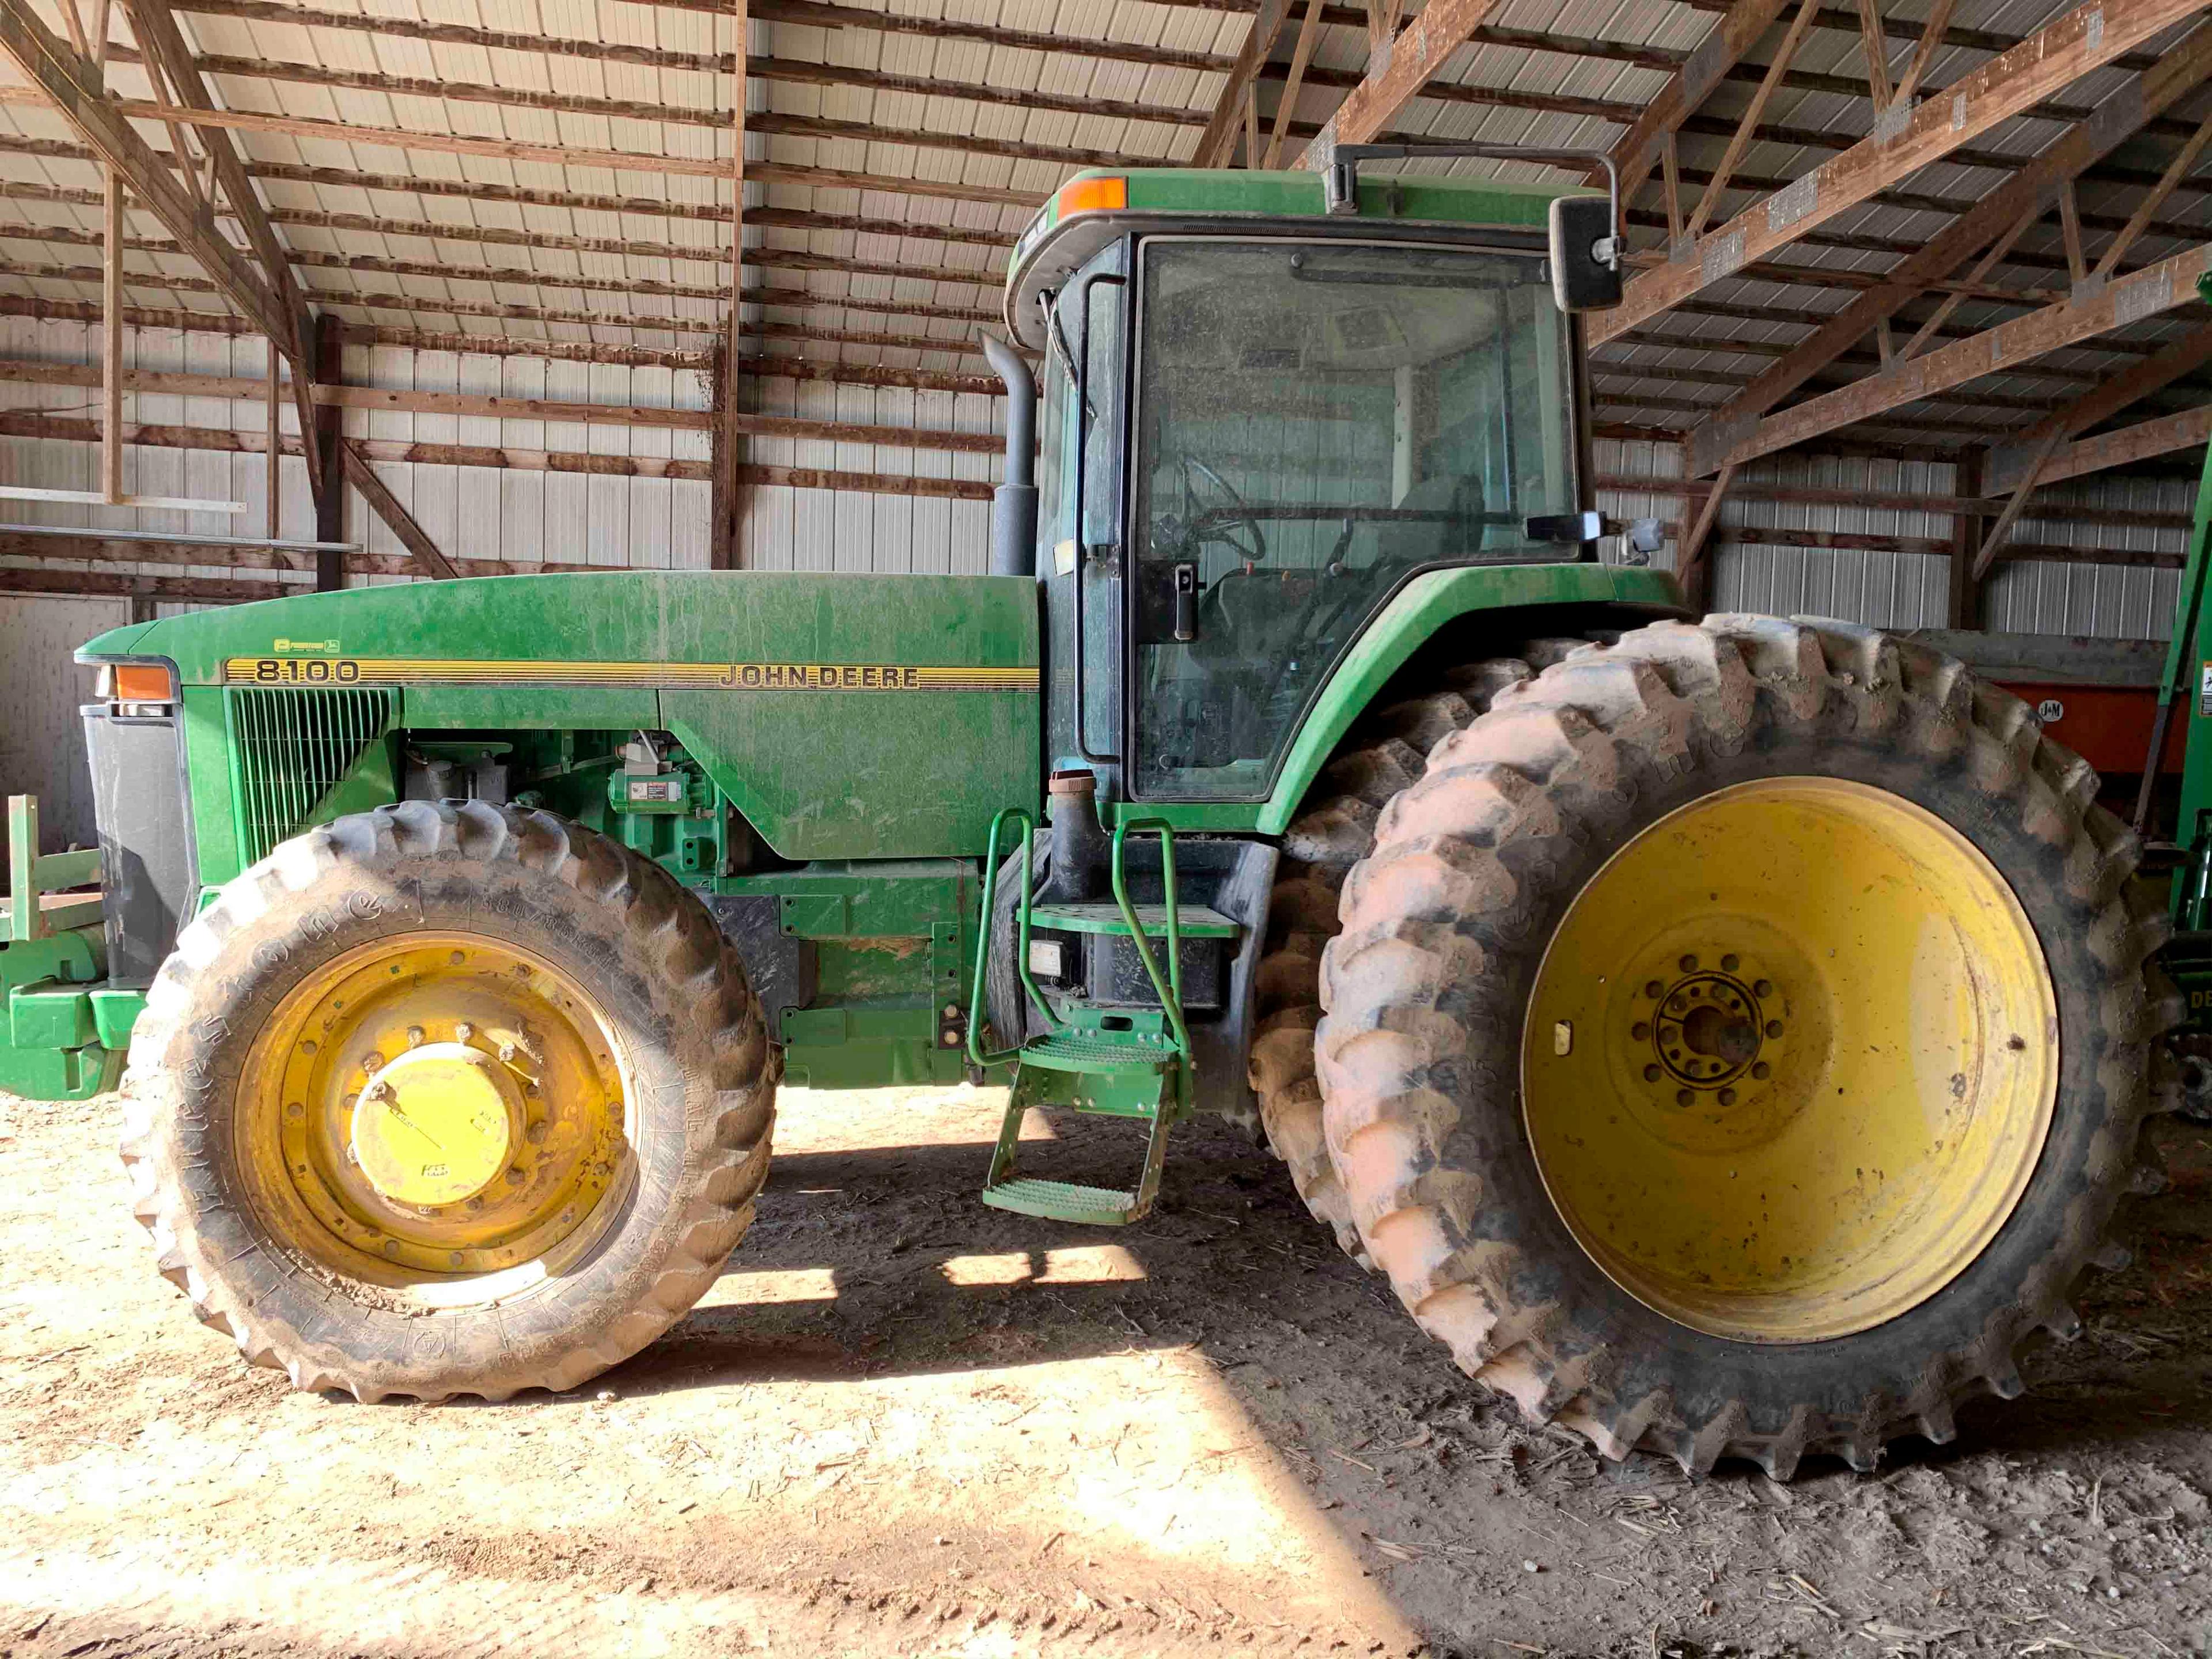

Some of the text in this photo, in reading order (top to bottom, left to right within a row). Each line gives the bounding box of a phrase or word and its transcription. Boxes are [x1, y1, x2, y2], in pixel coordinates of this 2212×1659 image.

[255, 660, 360, 684] 8100
[720, 665, 919, 687] JOHN DEERE
